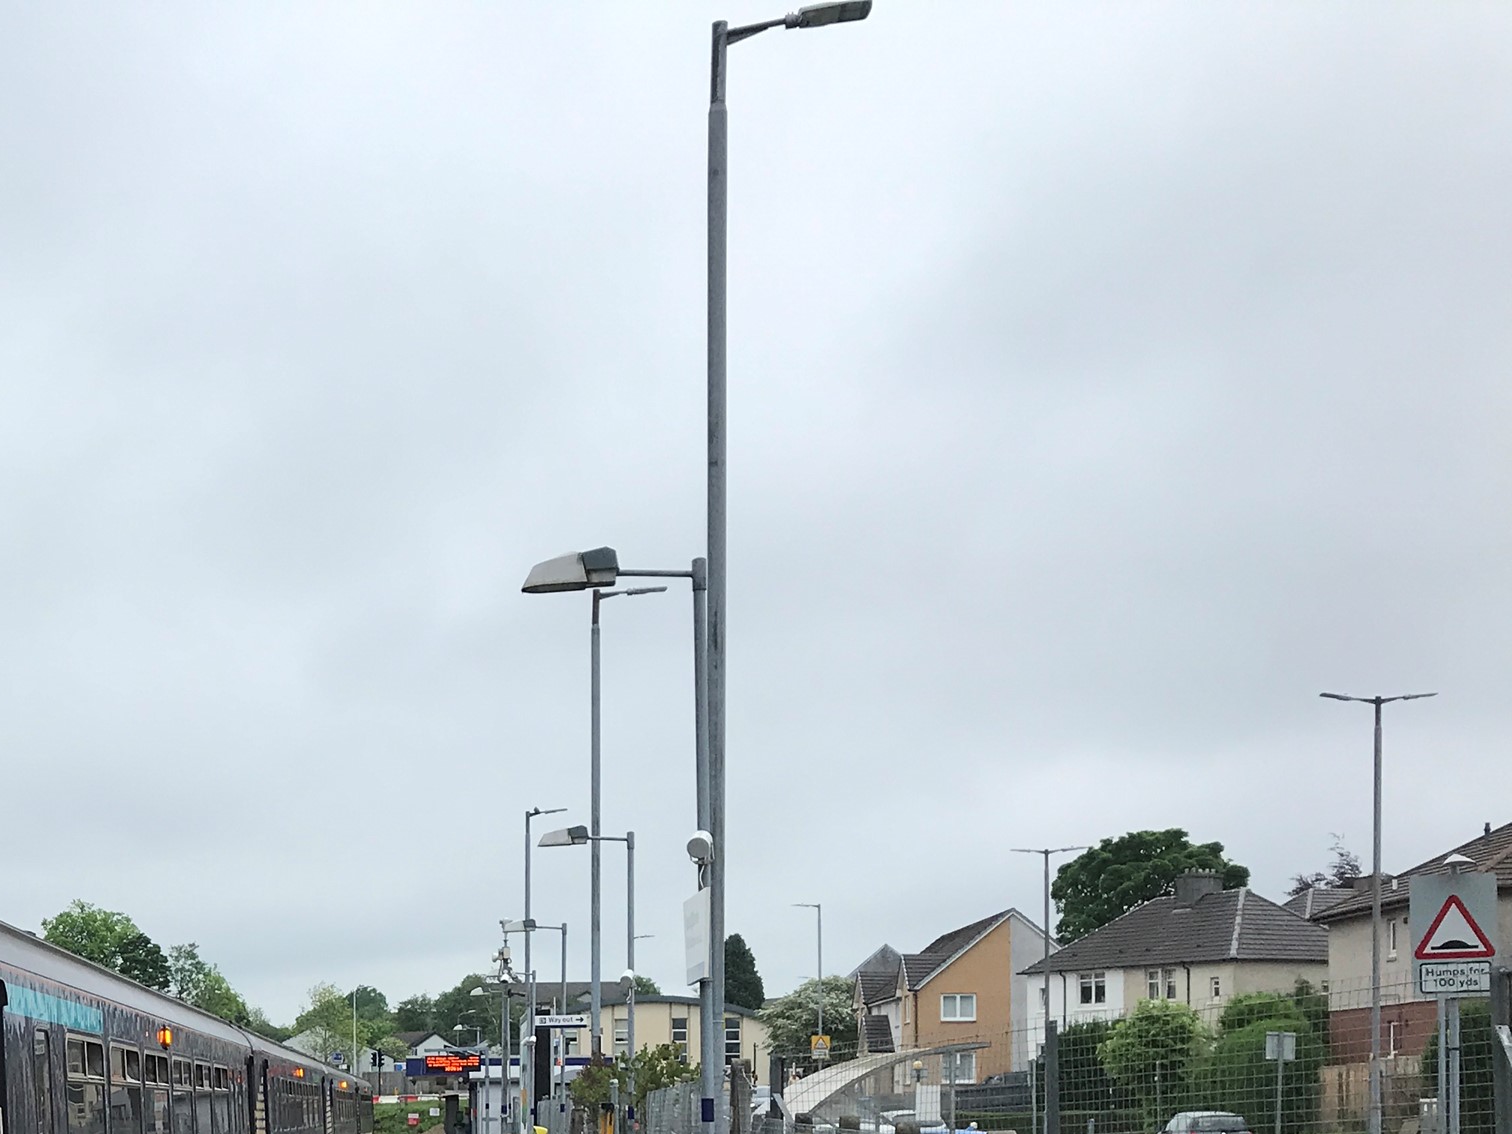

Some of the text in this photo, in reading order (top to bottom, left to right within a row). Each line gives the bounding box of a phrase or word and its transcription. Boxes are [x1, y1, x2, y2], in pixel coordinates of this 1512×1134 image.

[1425, 966, 1486, 978] Humps for
[1433, 977, 1479, 988] 100 yds
[548, 1016, 561, 1024] Way
